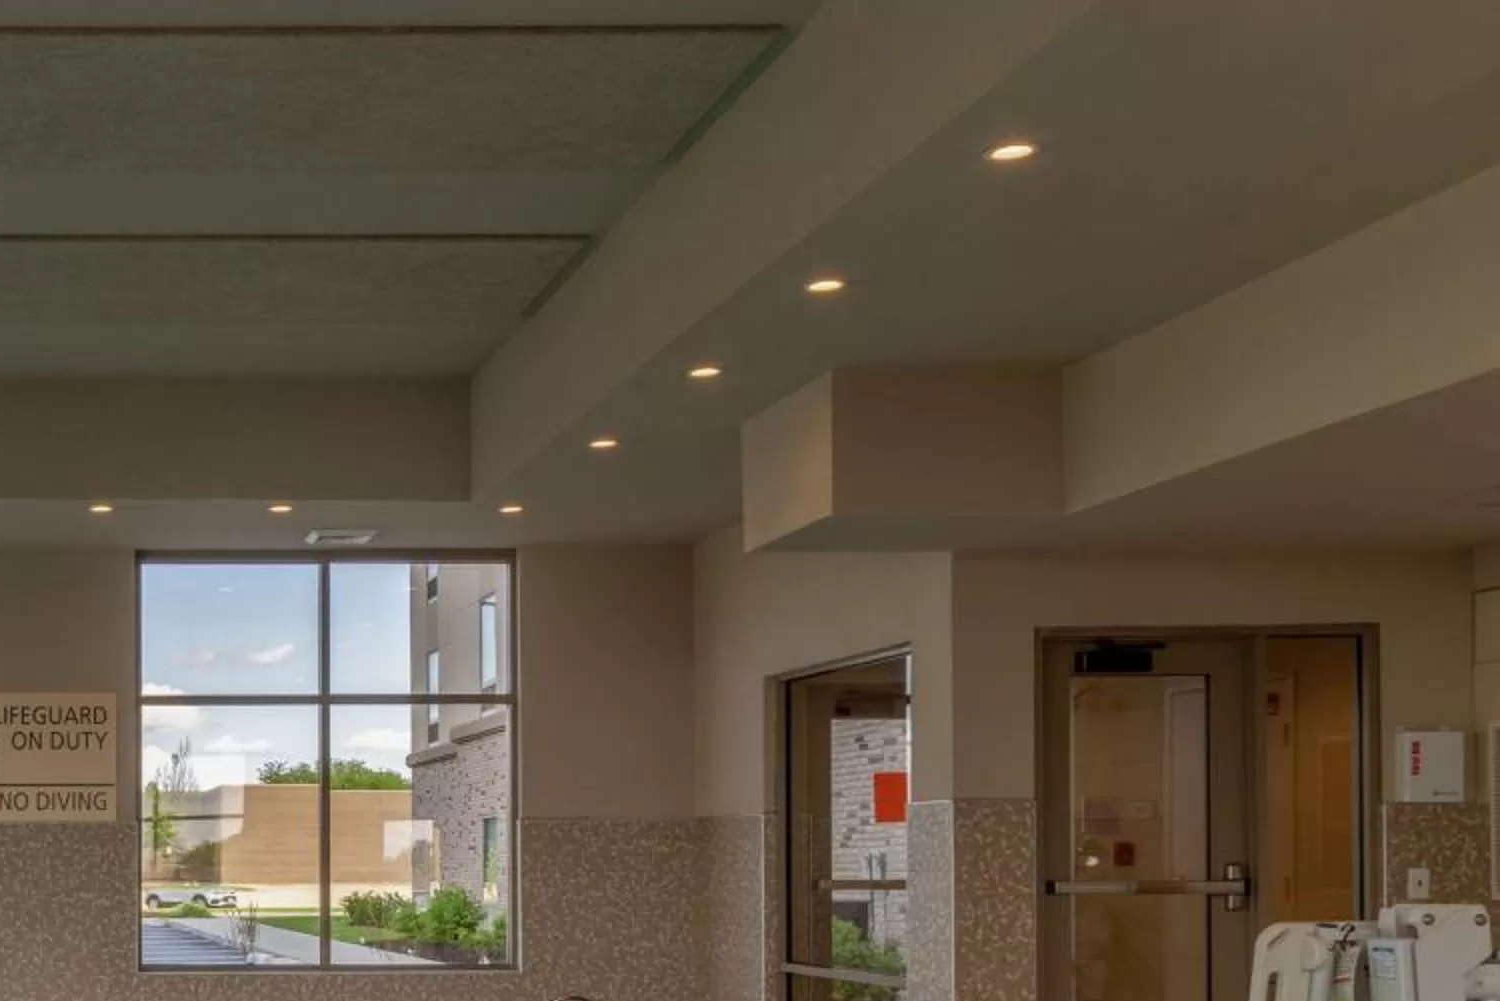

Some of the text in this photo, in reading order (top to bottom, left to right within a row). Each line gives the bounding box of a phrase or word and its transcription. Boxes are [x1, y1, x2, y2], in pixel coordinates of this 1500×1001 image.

[11, 731, 108, 751] ON DUTY
[36, 791, 108, 811] DIVING
